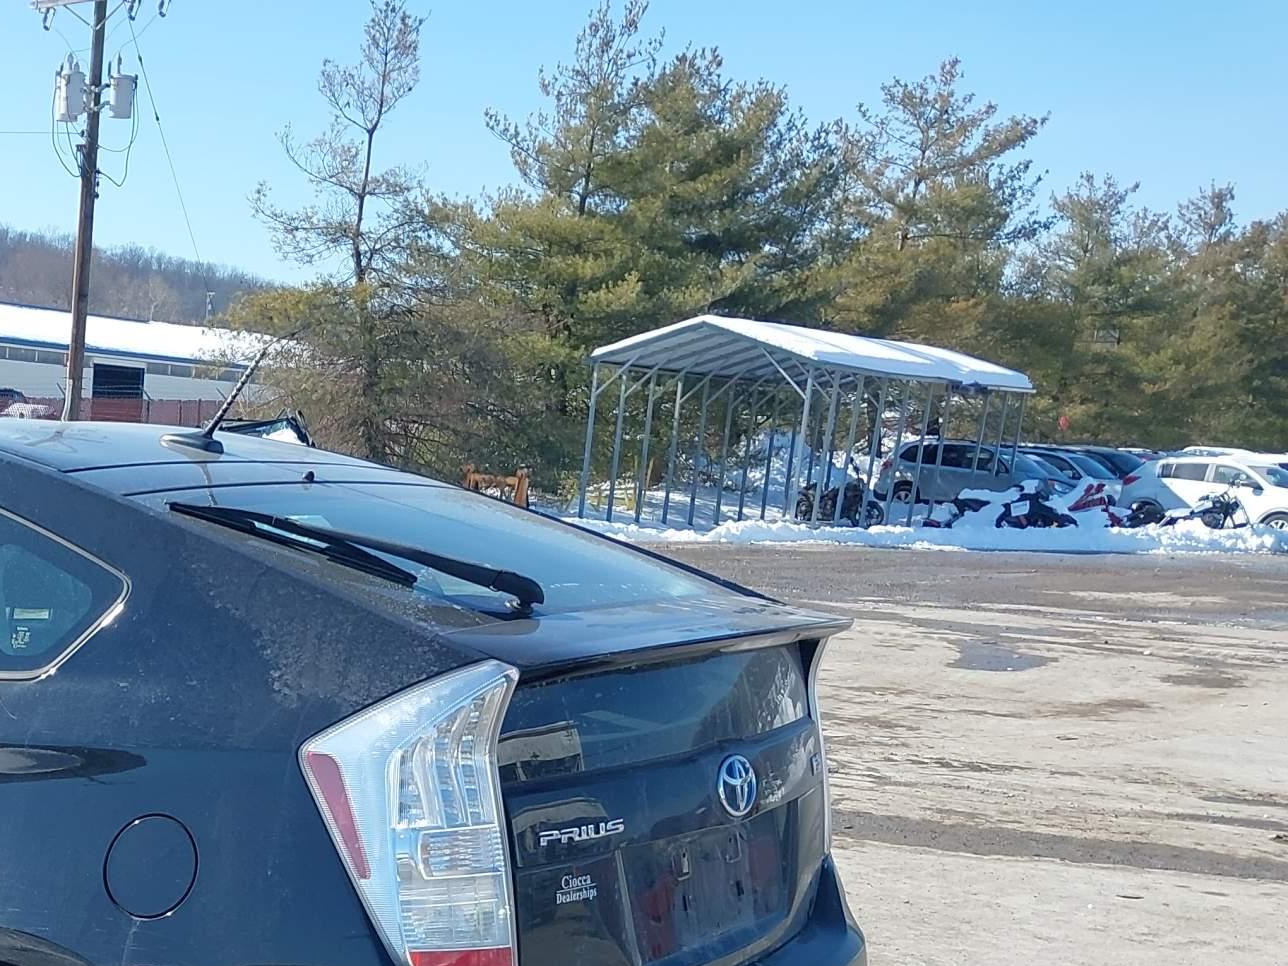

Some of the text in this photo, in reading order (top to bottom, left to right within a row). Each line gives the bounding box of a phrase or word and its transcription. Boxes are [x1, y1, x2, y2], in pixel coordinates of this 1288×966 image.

[539, 818, 624, 847] PRIUS
[561, 873, 592, 890] Ciocca
[556, 886, 597, 905] Dealerships
